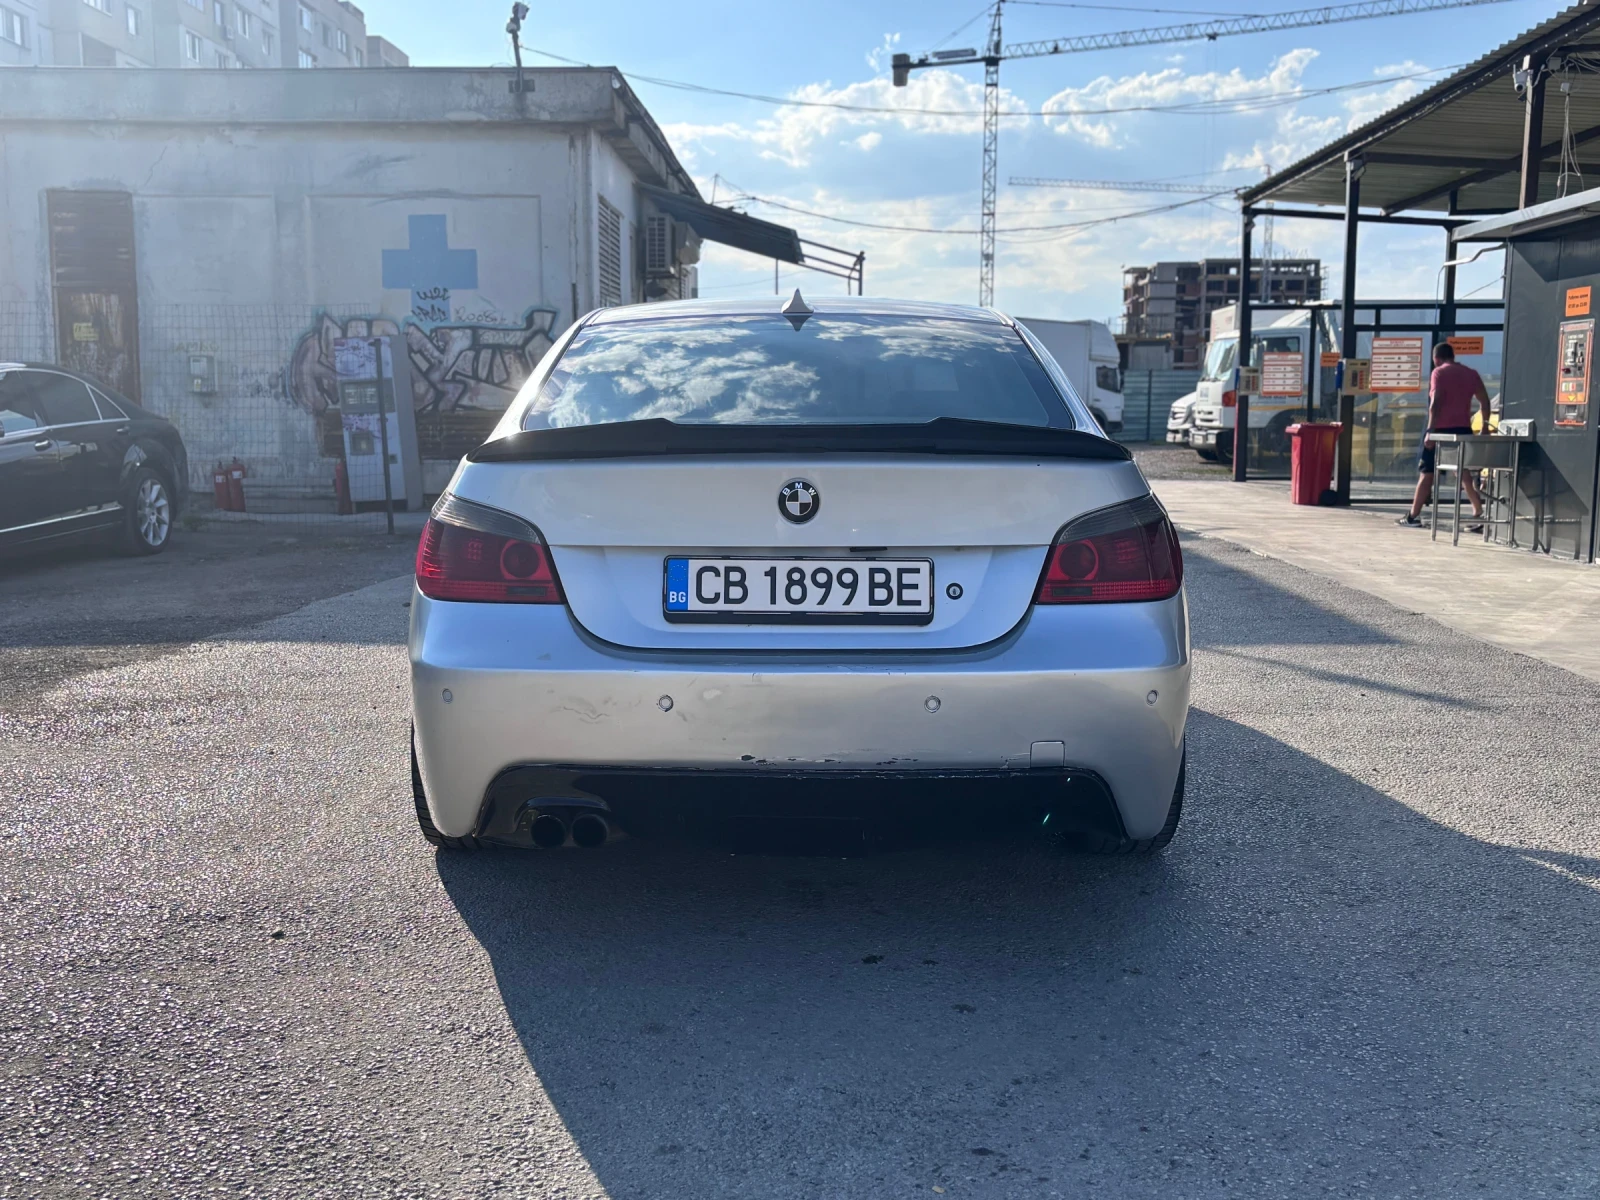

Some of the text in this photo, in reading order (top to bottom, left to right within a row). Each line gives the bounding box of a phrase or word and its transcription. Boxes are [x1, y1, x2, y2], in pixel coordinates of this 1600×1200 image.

[782, 482, 817, 496] BMW
[696, 565, 922, 607] CB 1899 BE
[669, 591, 687, 603] BG
